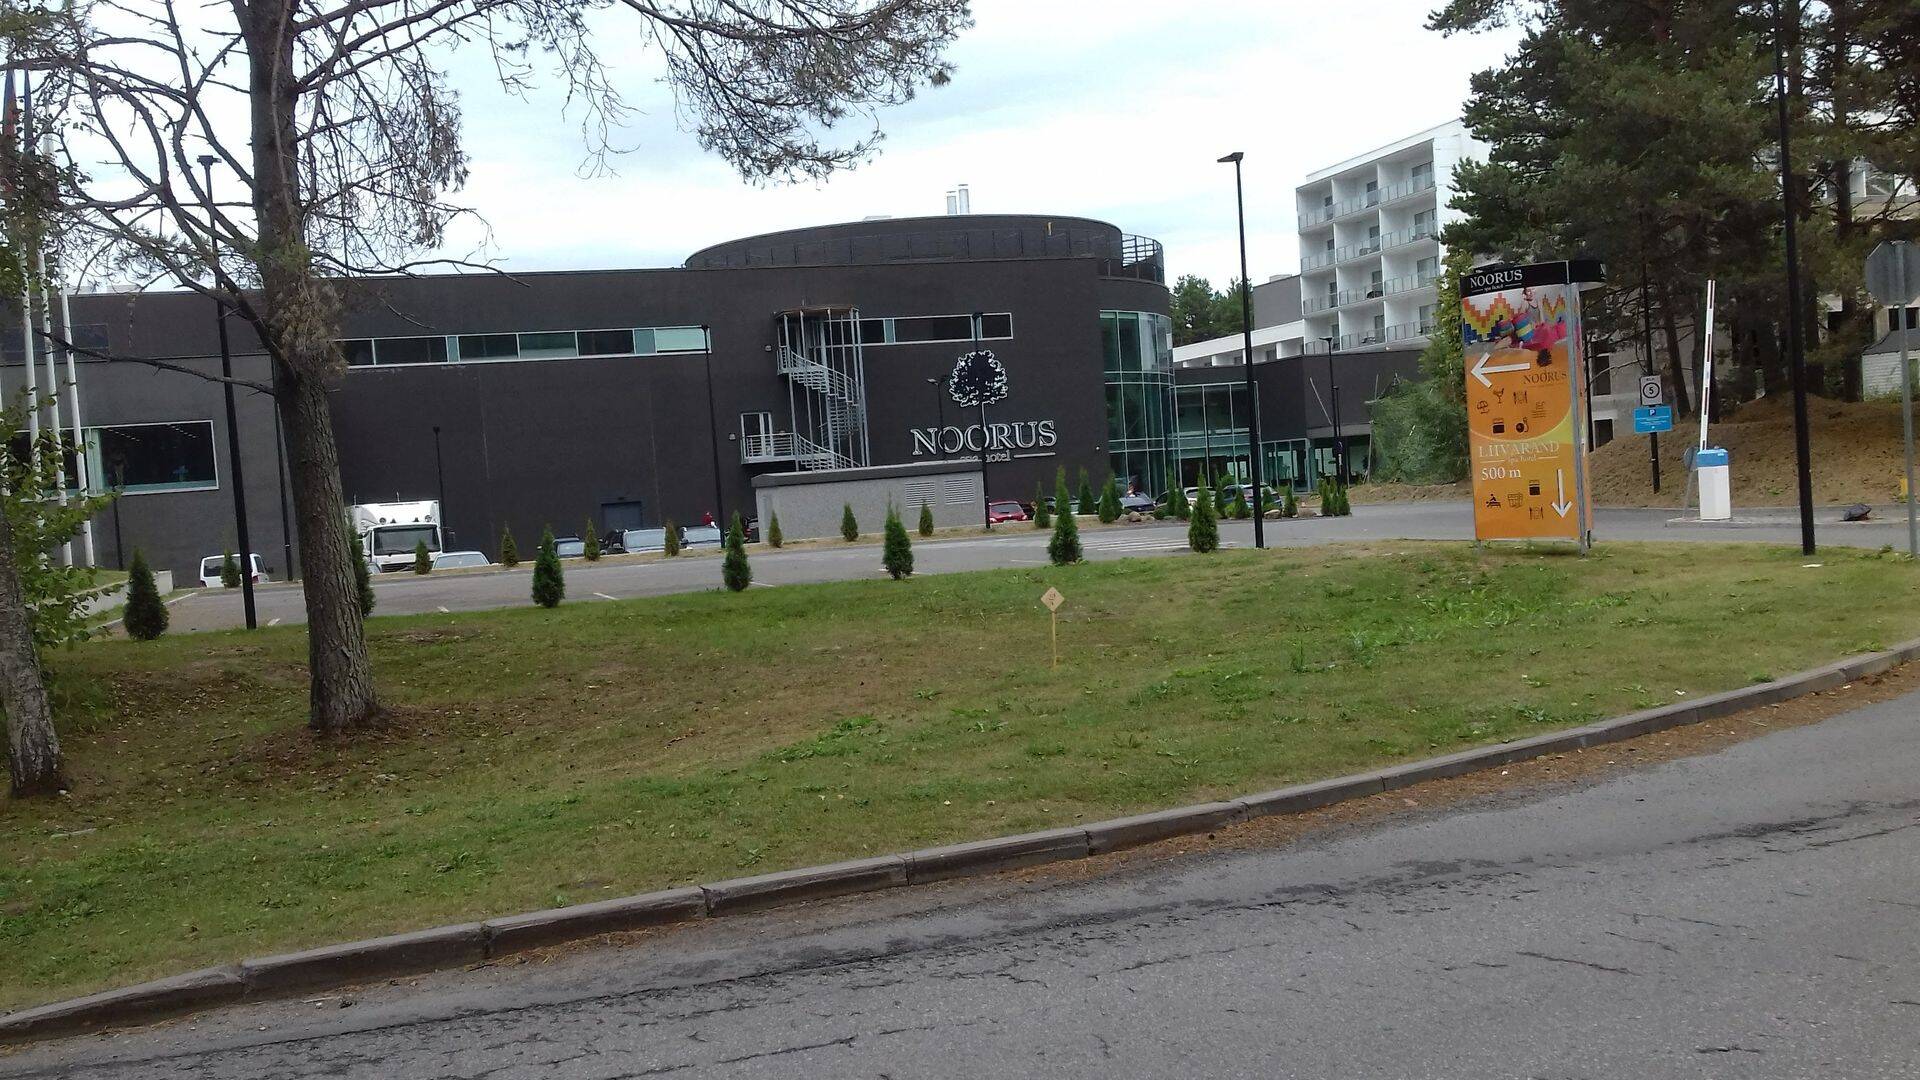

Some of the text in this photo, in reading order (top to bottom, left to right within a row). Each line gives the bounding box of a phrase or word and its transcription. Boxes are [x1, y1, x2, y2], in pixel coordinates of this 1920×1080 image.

[1470, 269, 1523, 288] NOORUS
[1522, 371, 1567, 385] NOORUS
[910, 420, 1058, 455] NOORUS
[1479, 441, 1560, 458] LIIVARAND
[1481, 466, 1521, 481] 500 m
